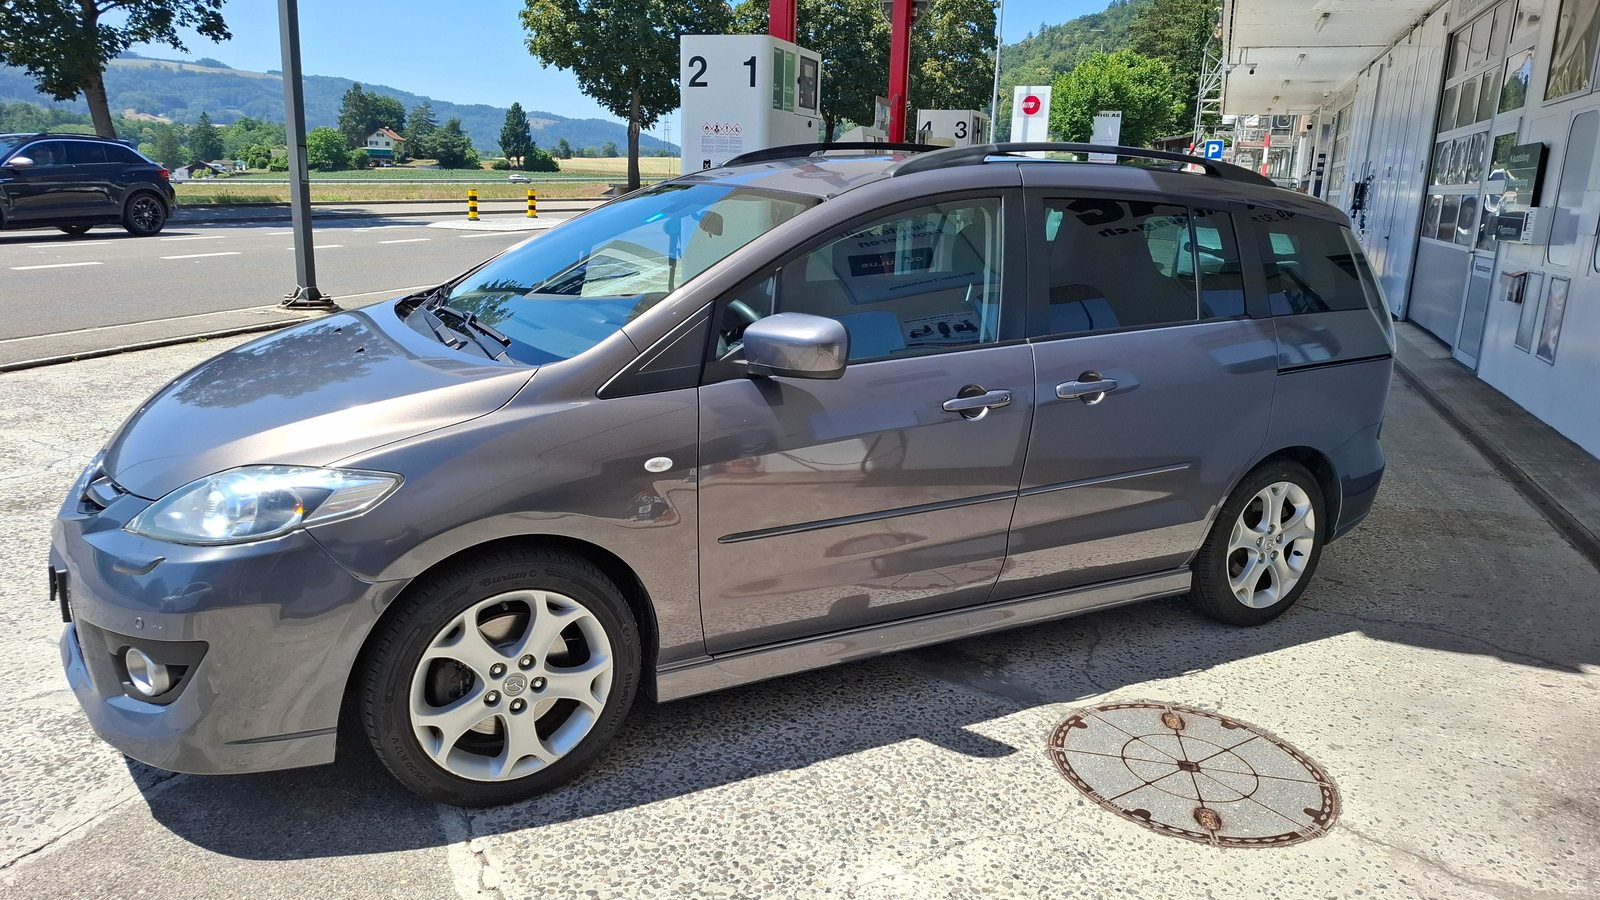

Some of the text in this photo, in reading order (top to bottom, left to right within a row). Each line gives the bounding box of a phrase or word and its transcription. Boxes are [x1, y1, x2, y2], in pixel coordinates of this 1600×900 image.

[688, 55, 708, 87] 2
[743, 56, 757, 87] 1
[954, 121, 967, 139] 3
[1207, 144, 1220, 158] P
